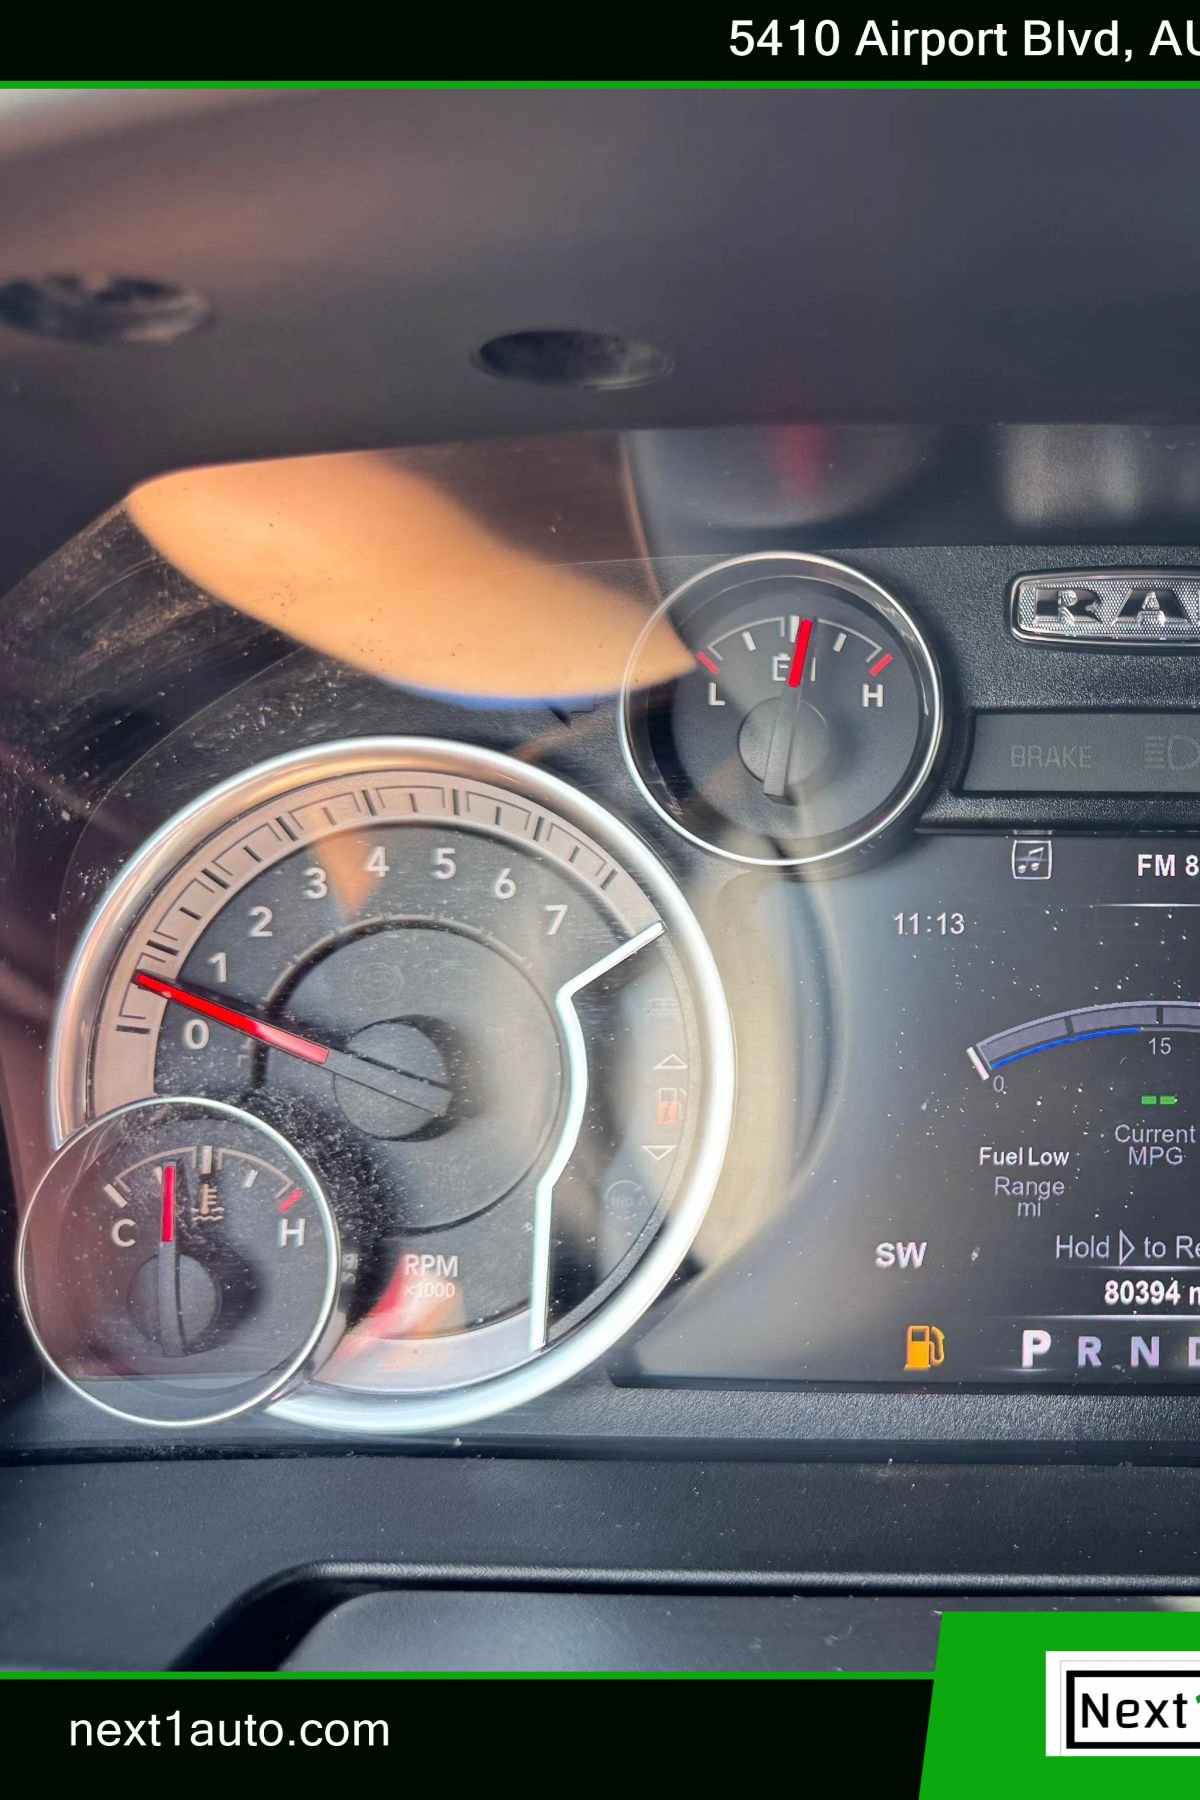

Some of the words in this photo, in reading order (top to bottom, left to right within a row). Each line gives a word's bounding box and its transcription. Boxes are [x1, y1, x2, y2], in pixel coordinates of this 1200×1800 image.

[862, 683, 884, 708] H
[1010, 744, 1093, 770] BRAKE
[366, 847, 389, 876] 4
[433, 848, 457, 876] 5
[1137, 854, 1176, 878] FM
[305, 867, 328, 897] 3
[494, 868, 518, 898] 6
[248, 906, 273, 937] 2
[544, 904, 568, 936] 7
[893, 912, 966, 936] 11:13
[210, 952, 227, 981] 1
[184, 1019, 208, 1050] 0
[1148, 1038, 1171, 1055] 15
[992, 1076, 1004, 1094] 0
[1114, 1124, 1196, 1145] Current
[979, 1147, 1024, 1167] Fuel
[1028, 1147, 1069, 1167] Low
[1128, 1146, 1183, 1167] MPG
[995, 1177, 1064, 1202] Range
[1017, 1199, 1041, 1217] mi
[111, 1220, 136, 1248] C
[279, 1219, 306, 1246] H
[875, 1242, 927, 1268] SW
[1055, 1235, 1110, 1259] Hold
[1144, 1237, 1167, 1258] to
[404, 1254, 459, 1278] RPM
[404, 1282, 456, 1298] x1000
[1104, 1281, 1181, 1306] 80394
[1021, 1329, 1052, 1368] P
[1077, 1336, 1102, 1366] R
[1130, 1336, 1161, 1367] N
